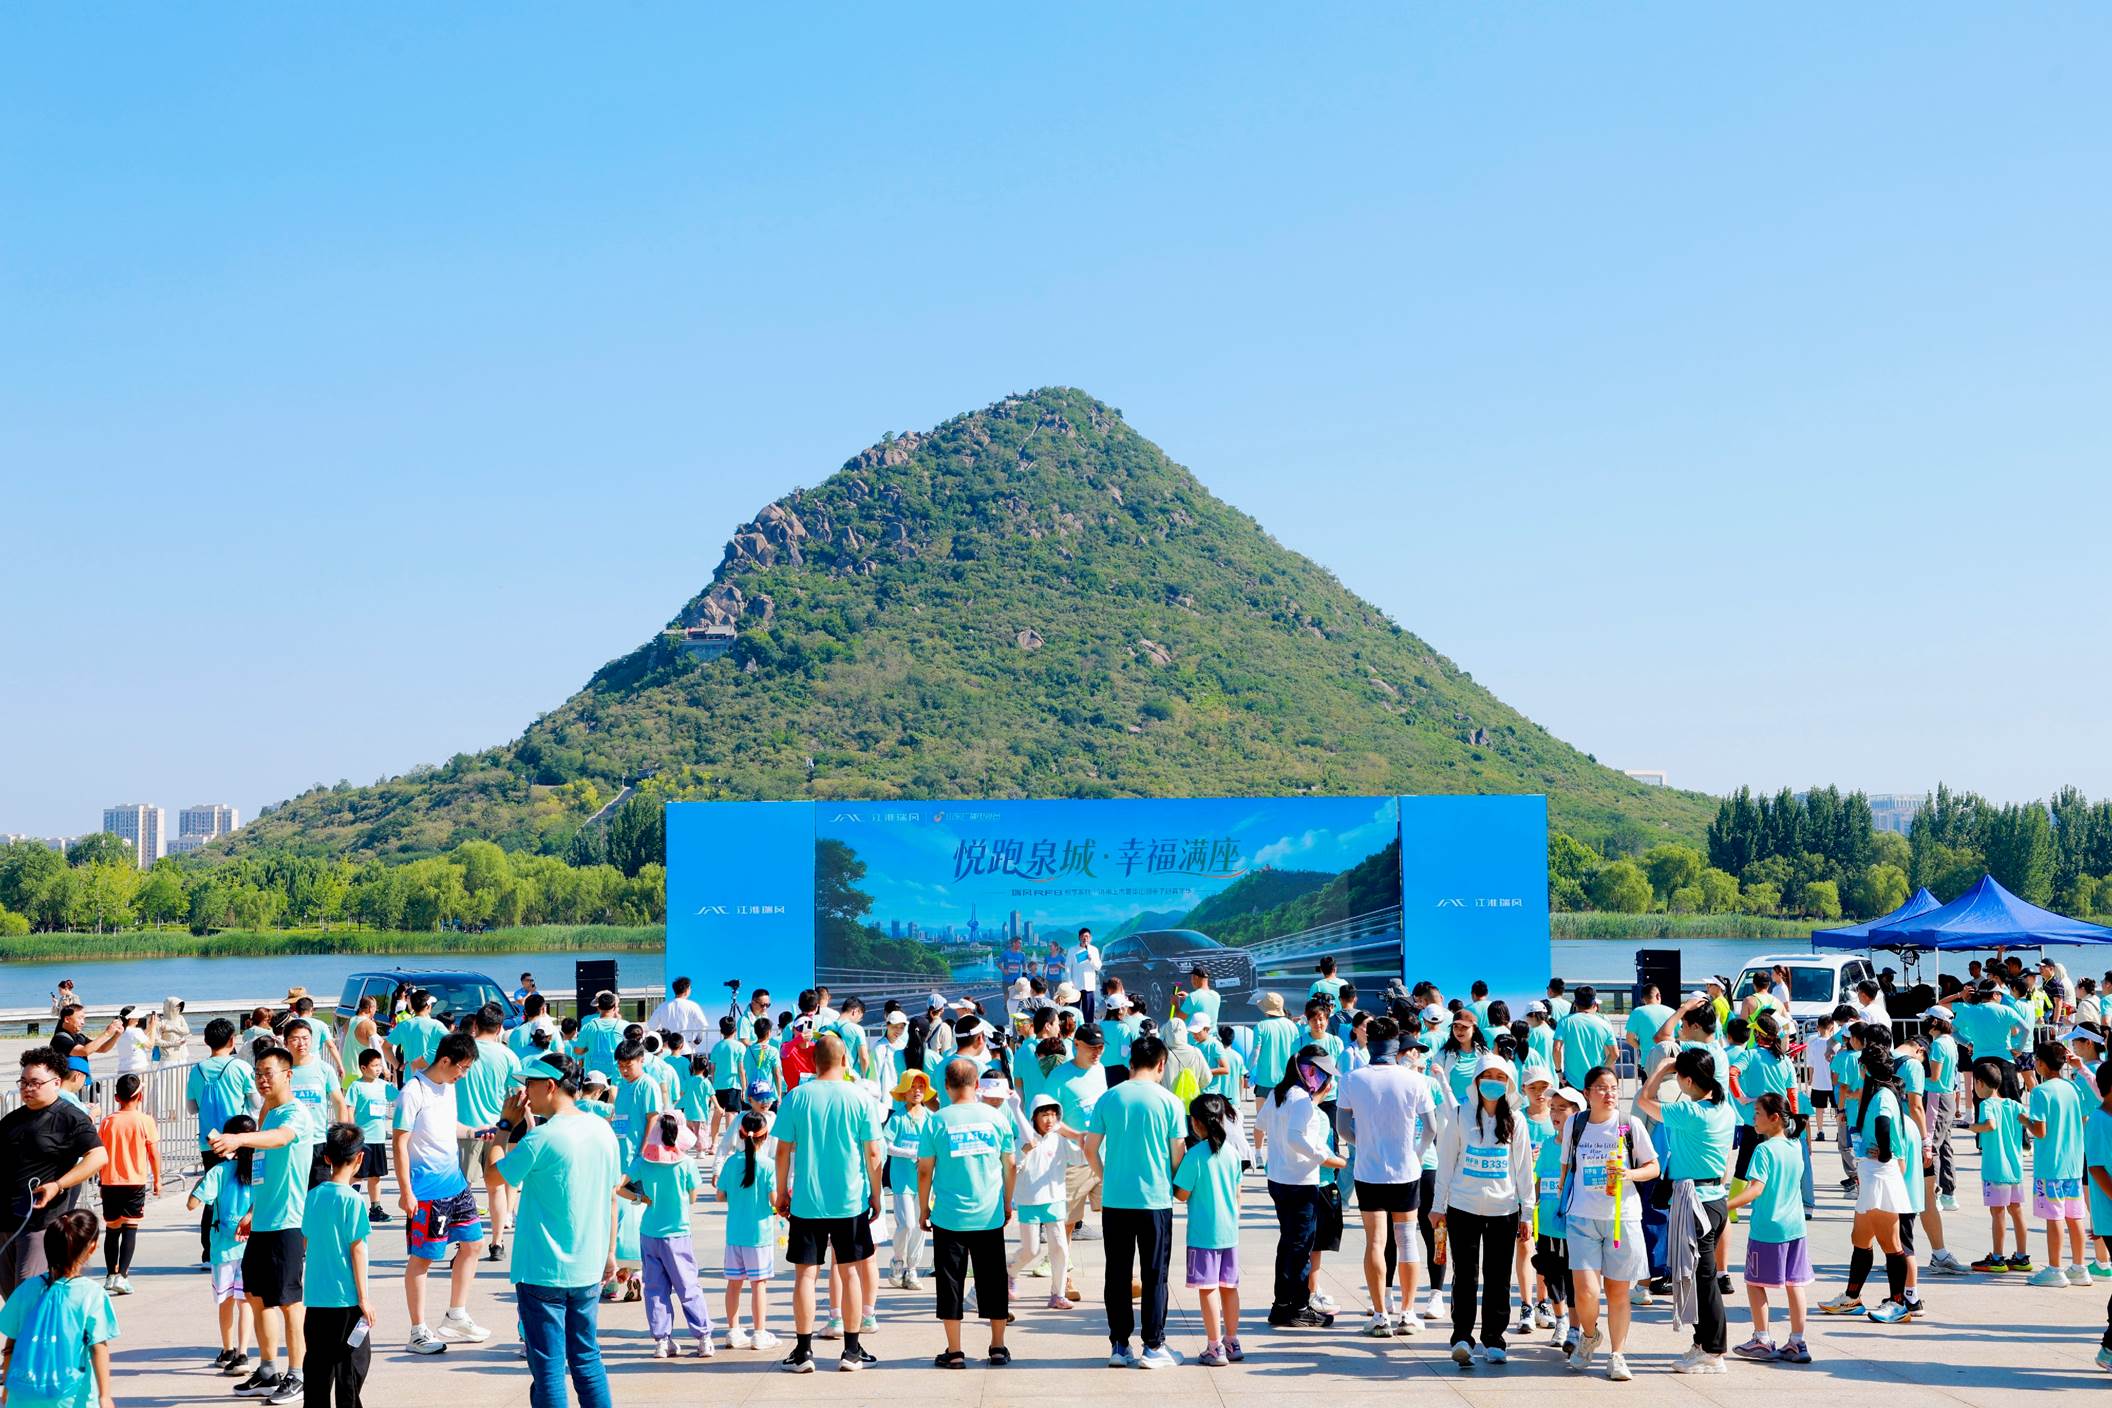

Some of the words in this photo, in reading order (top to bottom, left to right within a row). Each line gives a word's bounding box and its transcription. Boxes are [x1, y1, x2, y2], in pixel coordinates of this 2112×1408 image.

[1475, 898, 1522, 908] 江淮瑞风
[736, 905, 785, 915] 江淮瑞风
[1481, 1159, 1508, 1169] B339
[438, 1216, 447, 1235] 7
